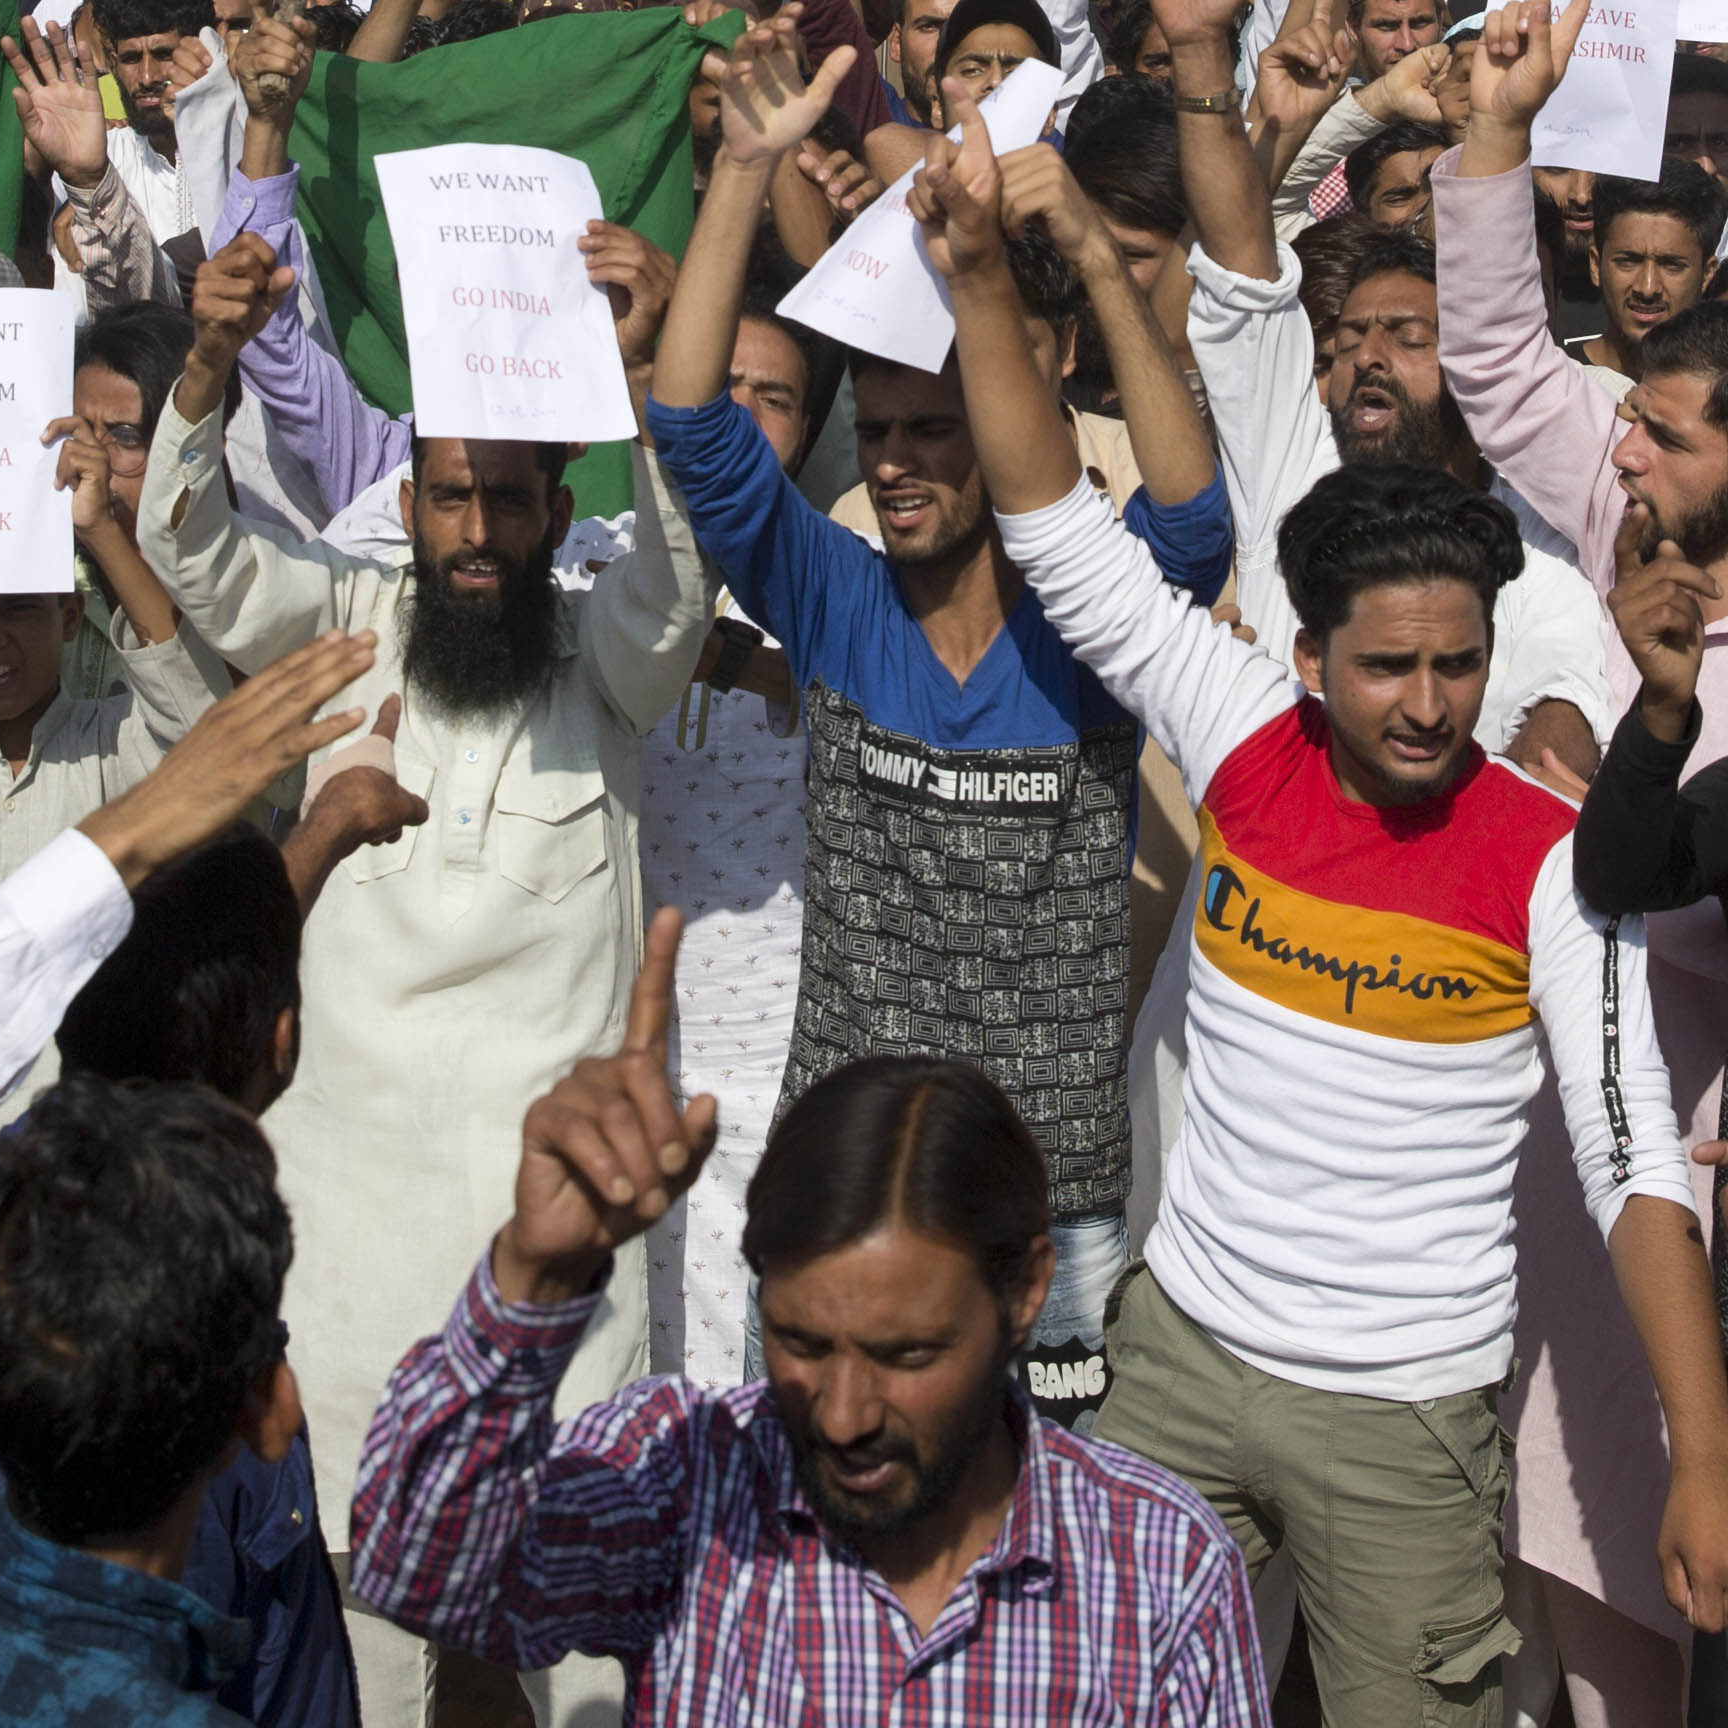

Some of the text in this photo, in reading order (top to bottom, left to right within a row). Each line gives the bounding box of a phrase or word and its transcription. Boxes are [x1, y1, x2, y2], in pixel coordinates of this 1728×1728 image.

[1583, 7, 1636, 29] EAVE
[430, 172, 550, 193] WE WANT
[439, 225, 555, 248] FREEDOM
[845, 248, 889, 280] NOW
[452, 287, 552, 317] GO INDIA
[465, 353, 564, 380] GO BACK
[860, 743, 1059, 802] TOMMY HILFIGER
[1203, 864, 1479, 1014] Champion
[1604, 940, 1616, 1014] Champion
[1027, 1355, 1106, 1400] BANG
